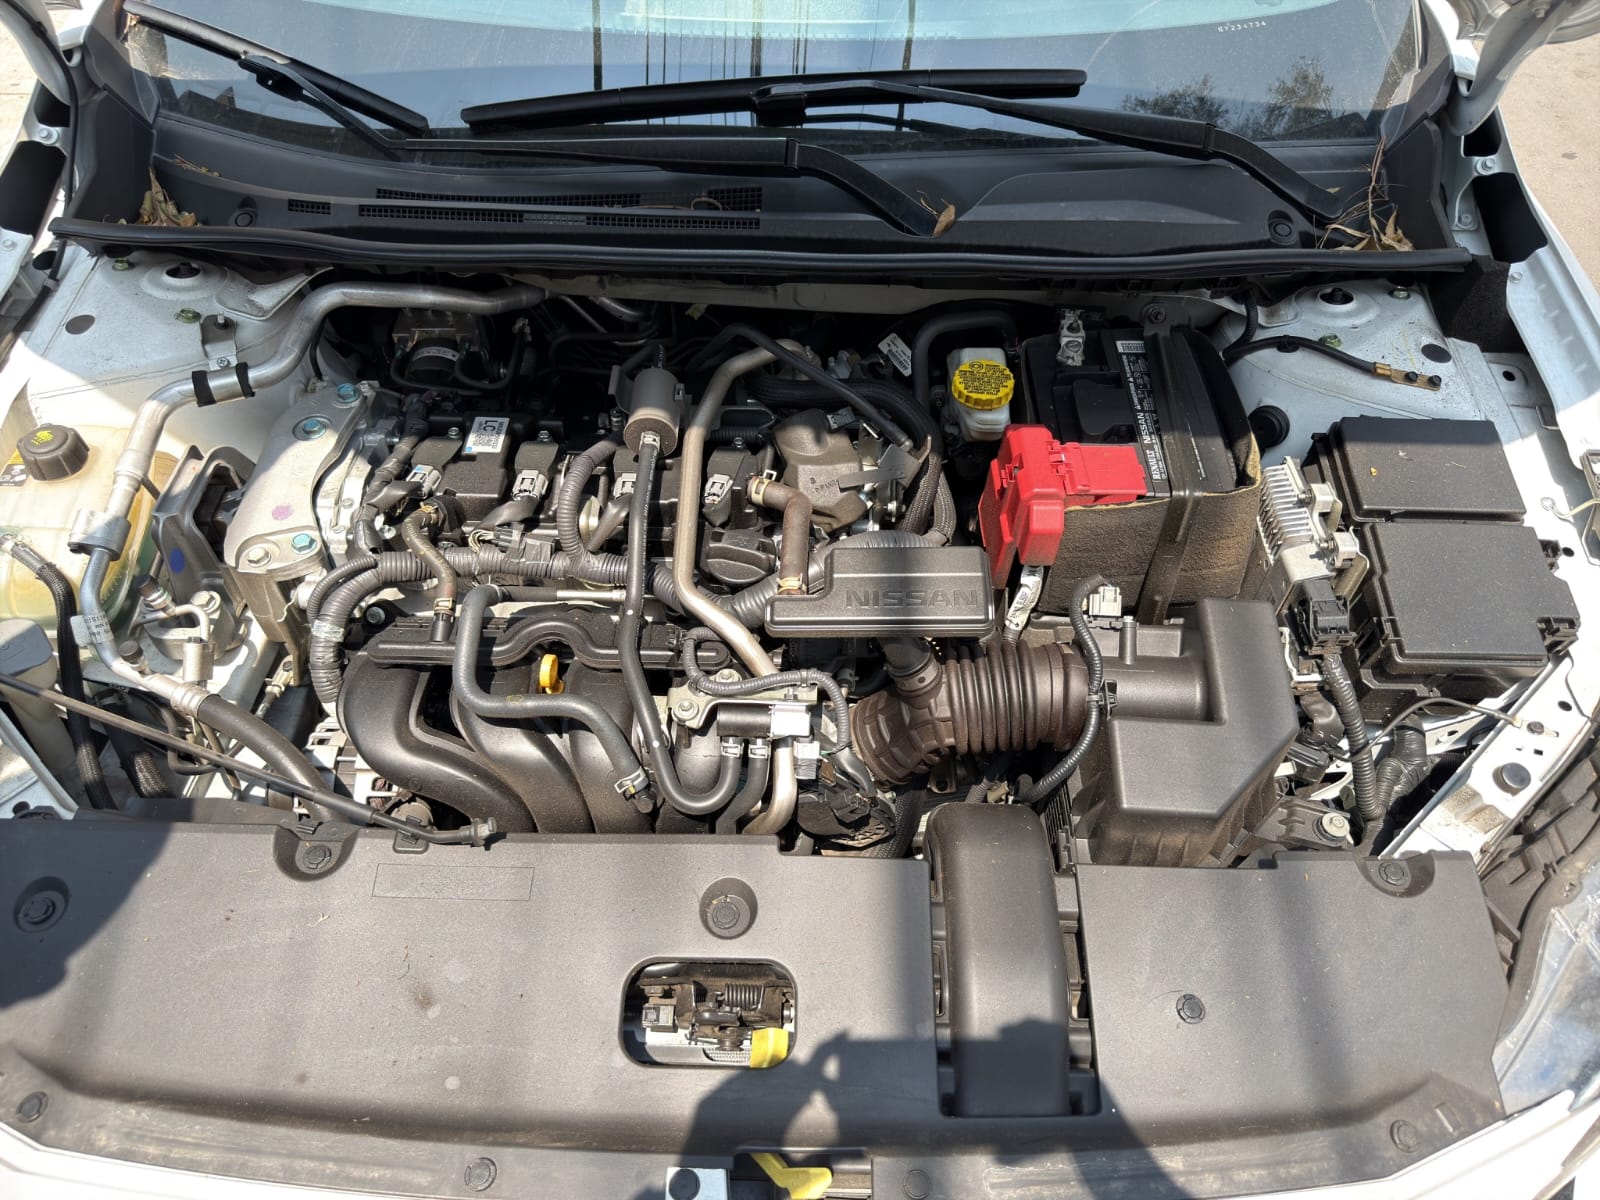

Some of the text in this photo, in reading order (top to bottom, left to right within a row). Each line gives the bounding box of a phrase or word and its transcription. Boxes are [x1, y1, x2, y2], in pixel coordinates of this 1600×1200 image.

[1136, 412, 1152, 444] NISSAN
[1146, 450, 1161, 479] RENAULT
[845, 589, 978, 609] NISSAN
